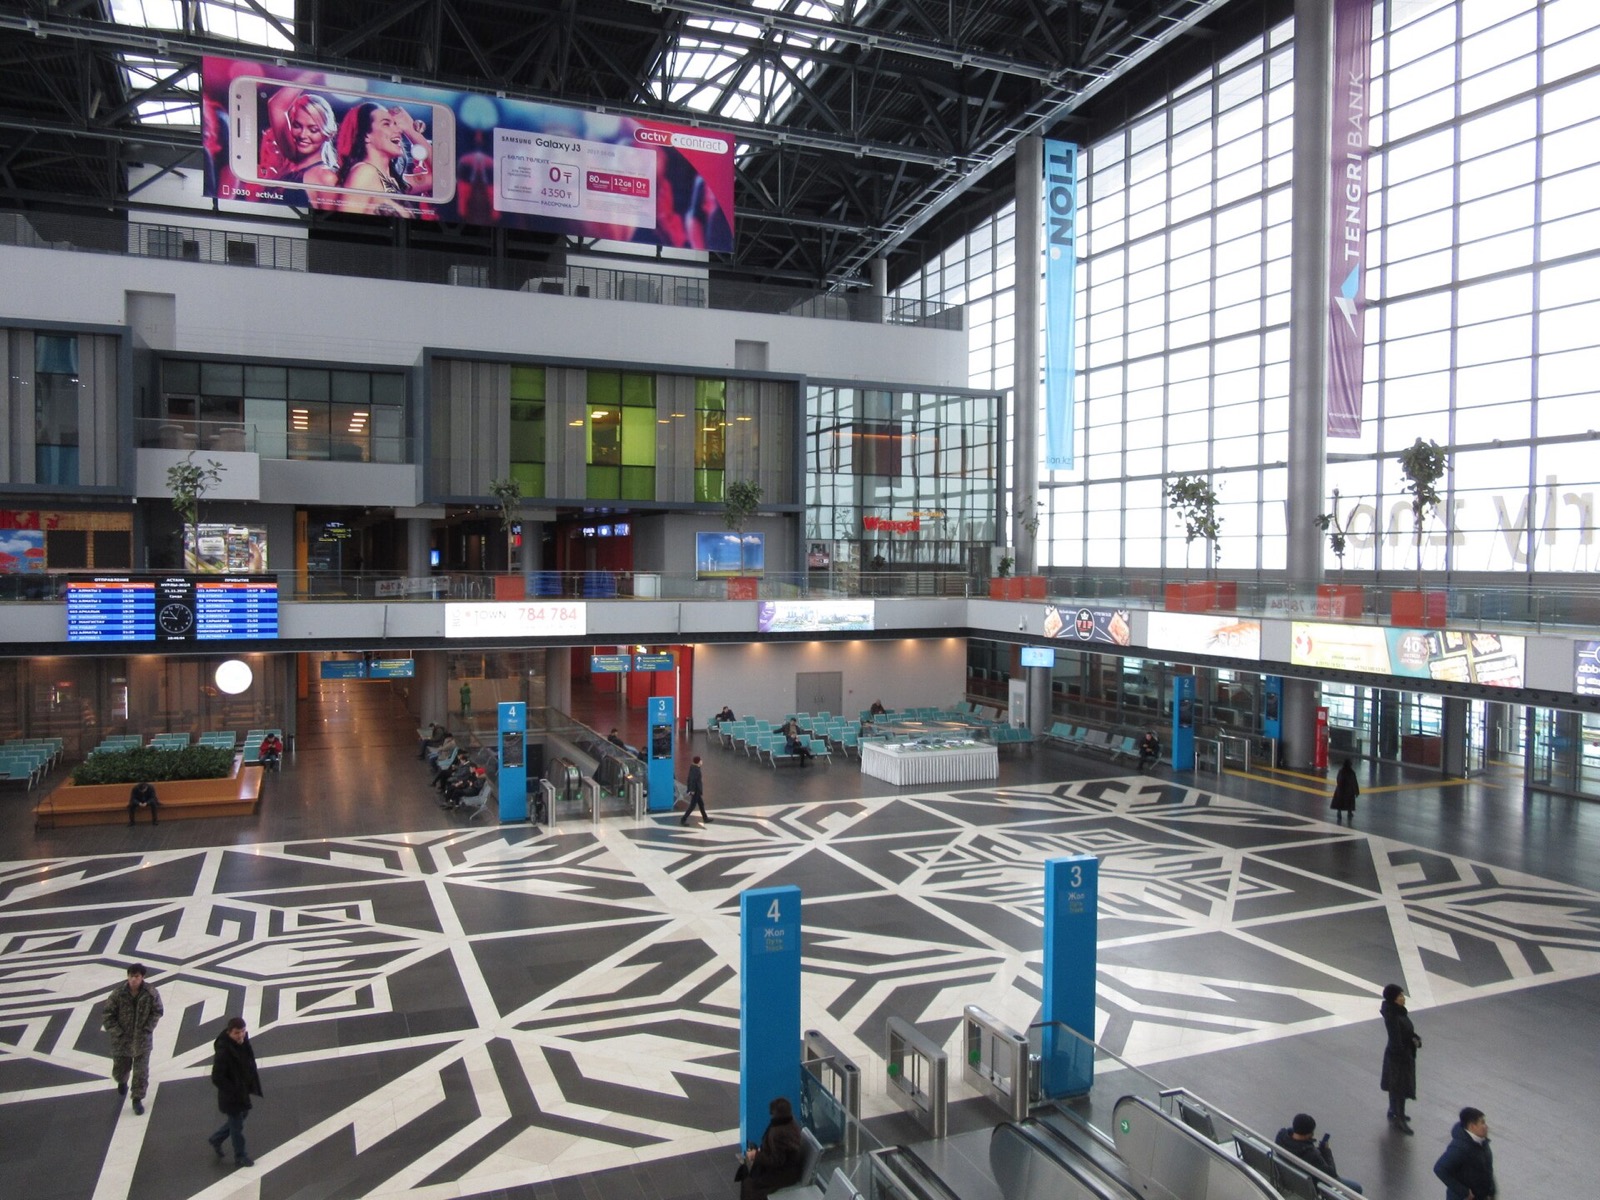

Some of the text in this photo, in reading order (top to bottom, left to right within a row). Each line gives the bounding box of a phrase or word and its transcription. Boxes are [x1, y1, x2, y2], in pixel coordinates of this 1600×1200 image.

[502, 136, 581, 153] SAMSUNG Galaxy J3
[640, 132, 721, 151] activ contract
[1345, 71, 1364, 261] TENGRI BANK
[231, 188, 284, 200] 3030 activ.kz
[518, 607, 577, 621] 784 784
[1077, 620, 1093, 629] VIP
[1184, 679, 1189, 688] 2
[508, 706, 516, 717] 4
[659, 700, 666, 711] 3
[1070, 865, 1082, 888] 3
[766, 898, 781, 923] 4
